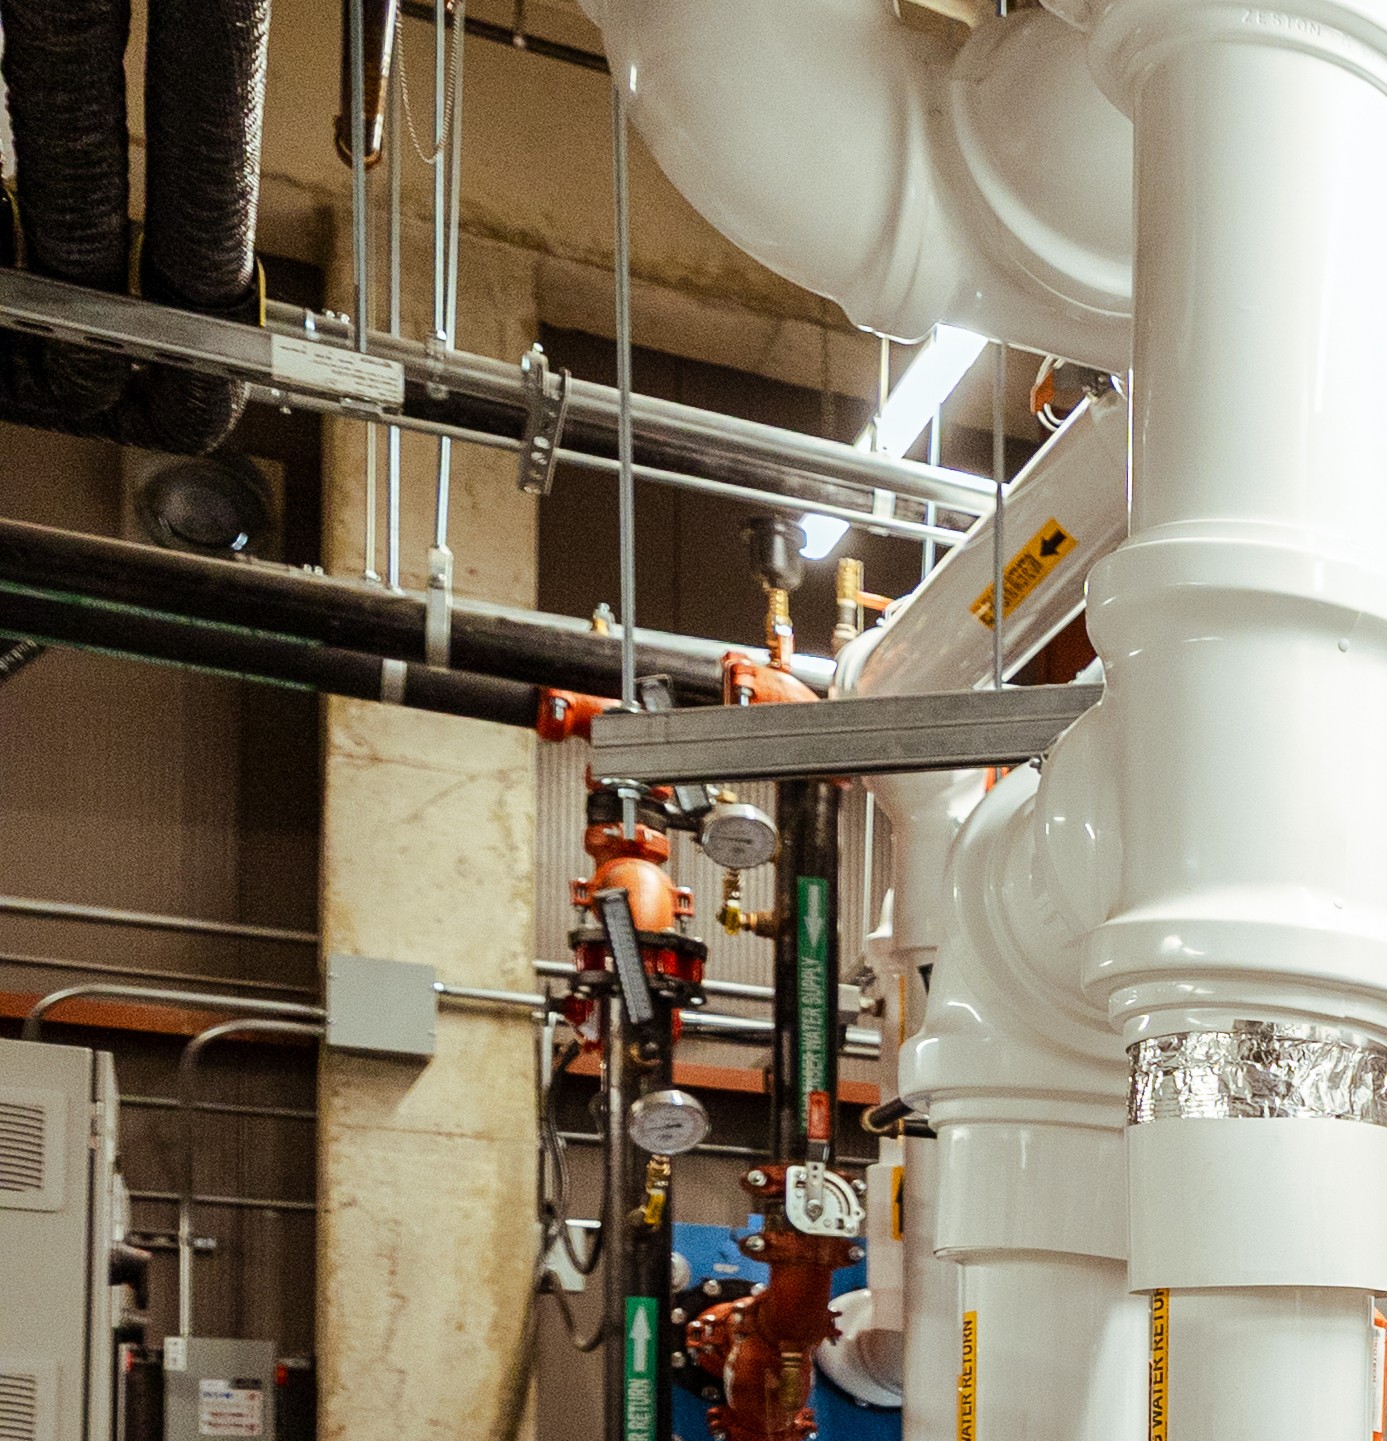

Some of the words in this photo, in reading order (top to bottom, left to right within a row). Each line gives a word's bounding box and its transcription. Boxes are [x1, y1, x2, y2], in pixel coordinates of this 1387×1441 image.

[801, 956, 822, 1005] SUPPLY
[801, 1007, 821, 1051] WATER
[961, 1319, 974, 1389] RETURN
[627, 1378, 650, 1430] RETURN
[1151, 1357, 1164, 1427] WATER
